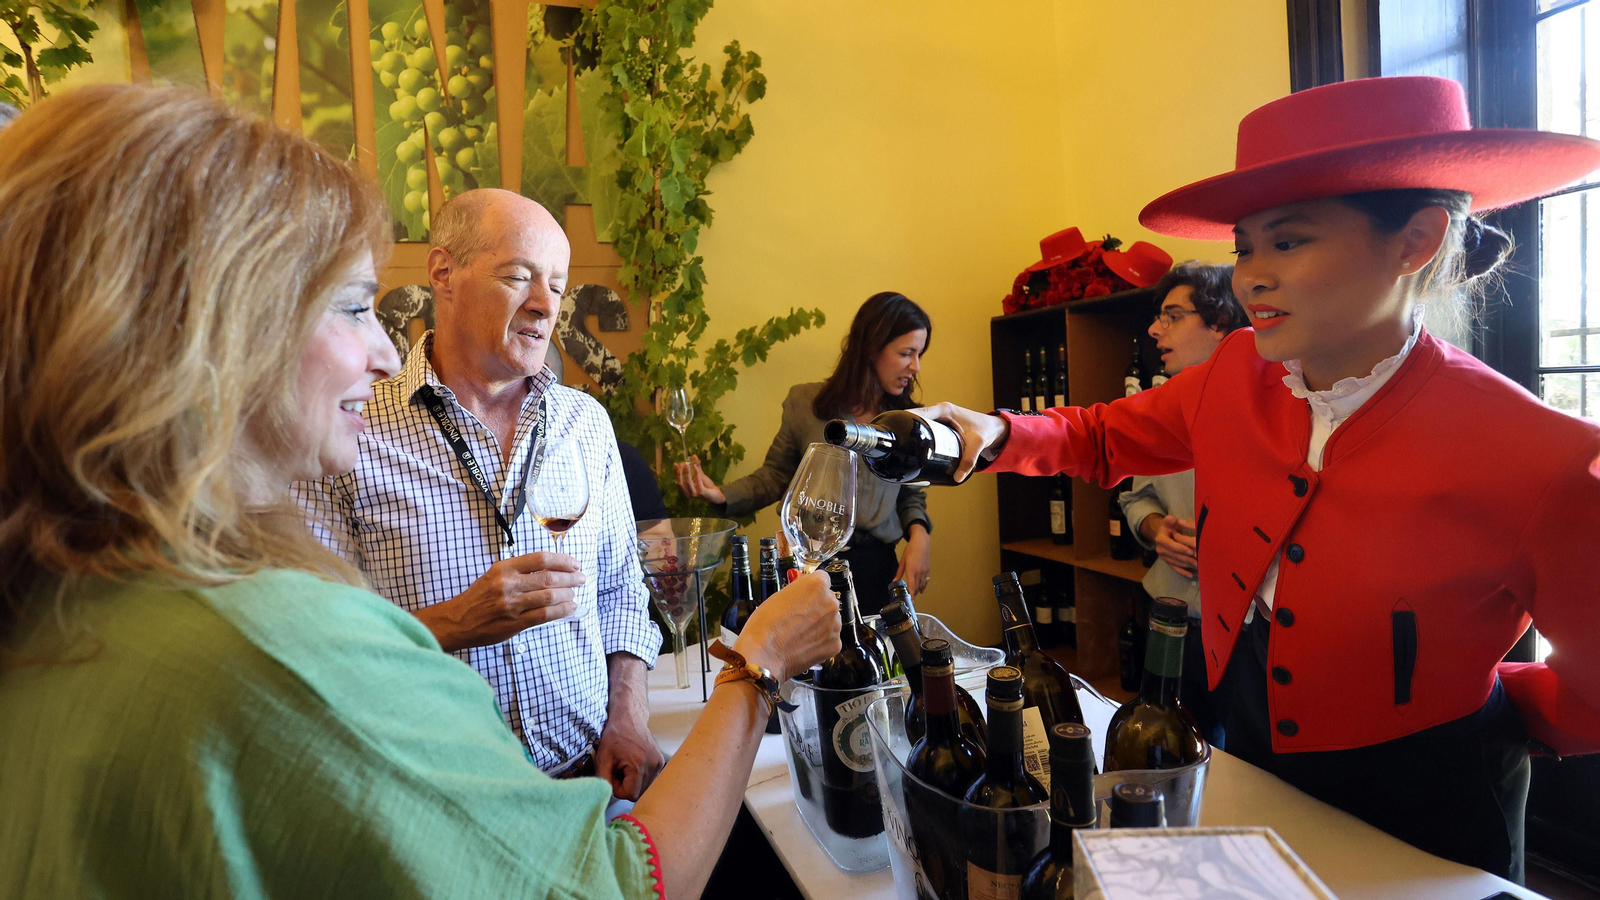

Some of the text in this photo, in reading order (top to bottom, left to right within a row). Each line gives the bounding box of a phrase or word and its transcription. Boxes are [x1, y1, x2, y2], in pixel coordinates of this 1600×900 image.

[435, 411, 461, 443] VINOBLE
[465, 459, 490, 493] VINOBLE
[798, 496, 845, 516] VINOBLE
[838, 698, 861, 713] TIO
